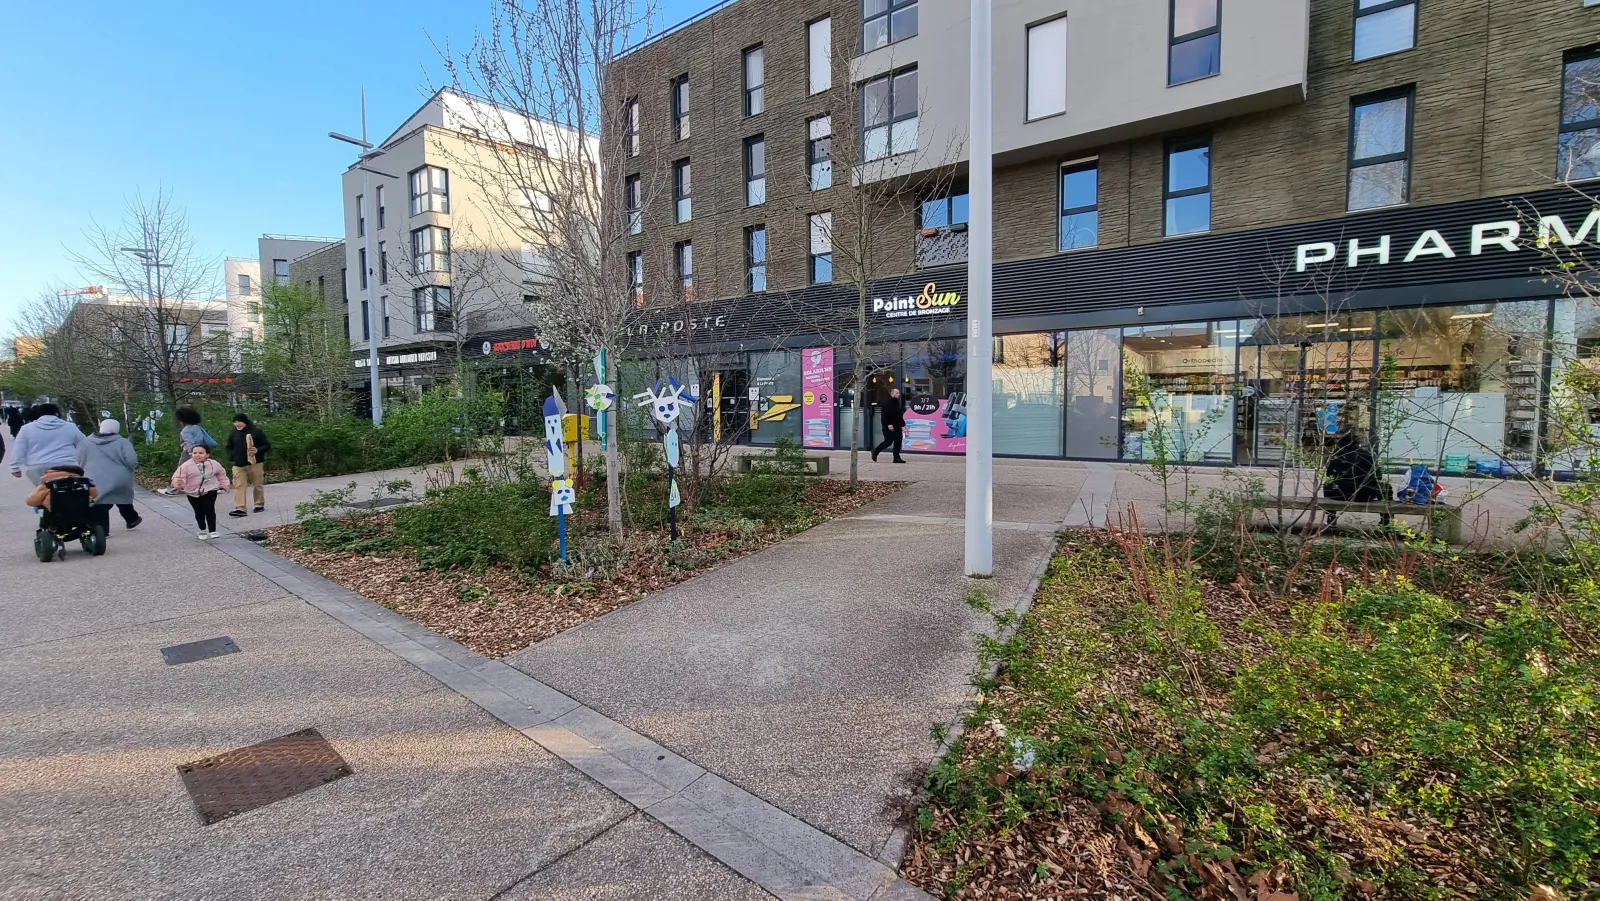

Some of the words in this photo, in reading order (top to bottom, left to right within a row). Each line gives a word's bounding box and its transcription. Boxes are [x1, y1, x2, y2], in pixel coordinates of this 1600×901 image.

[1296, 211, 1600, 273] PHARM
[873, 295, 915, 312] Point
[916, 282, 961, 309] Sun
[918, 307, 951, 315] BRONZAGE
[627, 325, 648, 336] LA
[660, 315, 727, 333] POSTE
